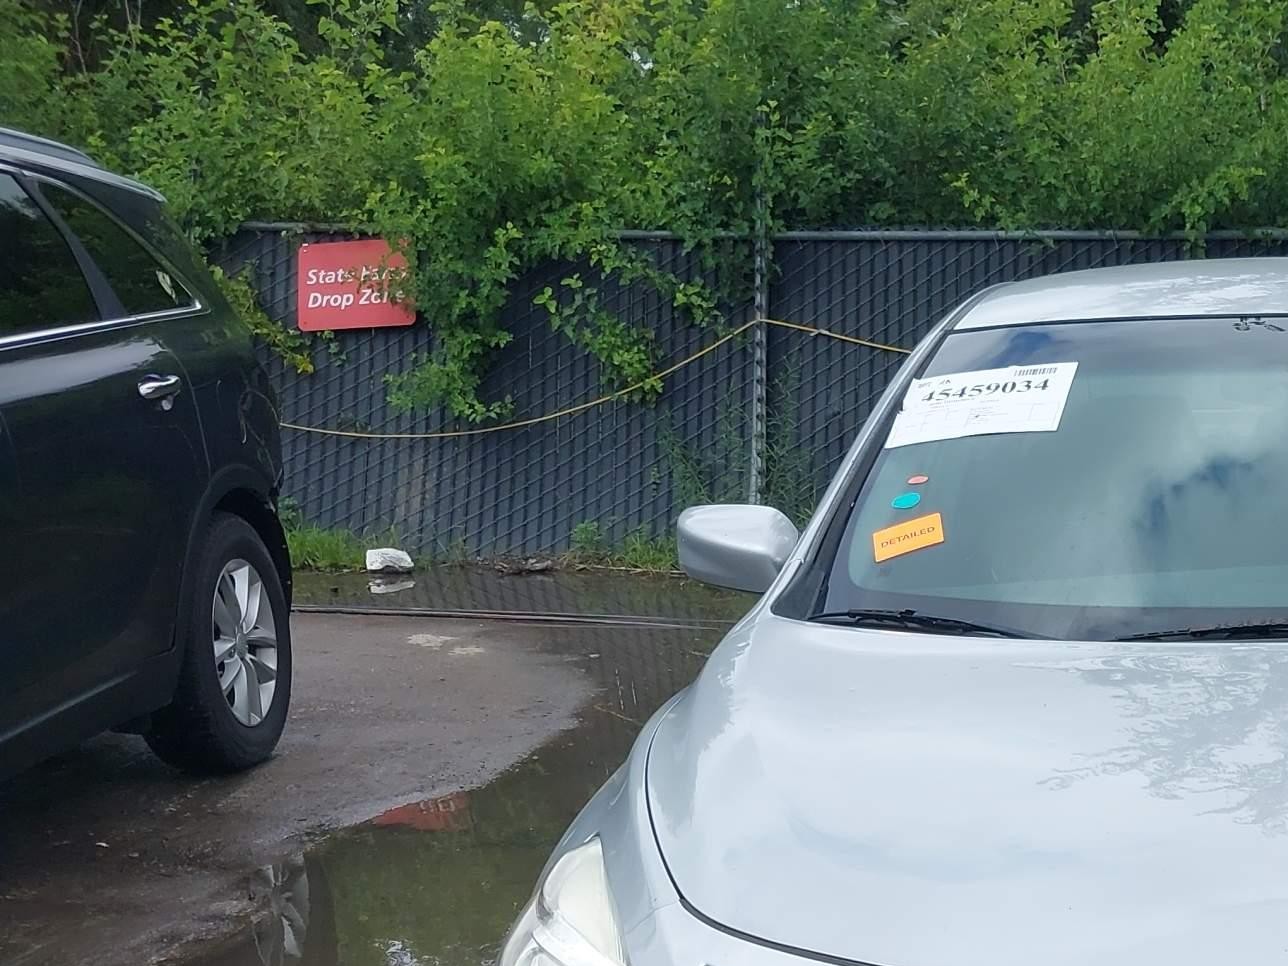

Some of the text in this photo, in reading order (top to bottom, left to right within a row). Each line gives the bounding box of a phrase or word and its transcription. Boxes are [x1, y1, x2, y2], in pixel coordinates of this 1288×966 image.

[307, 291, 354, 310] Drop
[921, 378, 1050, 402] 45459034
[880, 526, 936, 549] DETAILED
